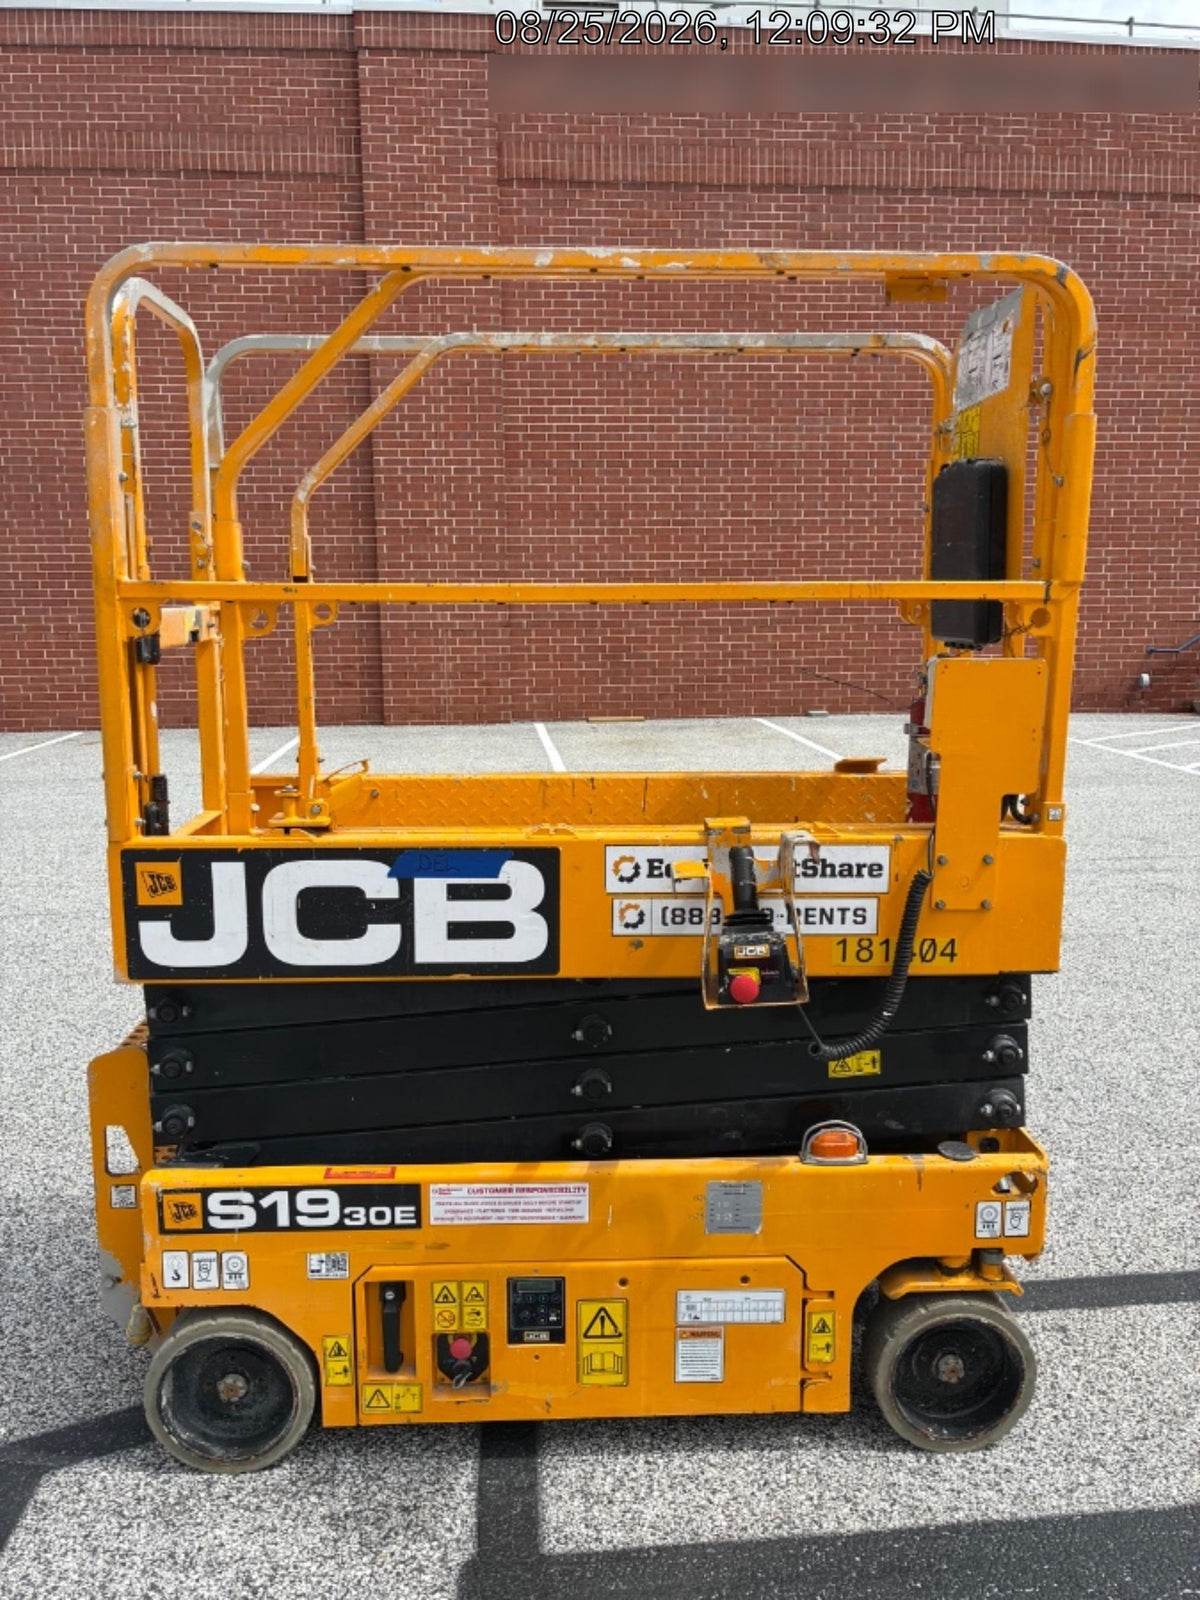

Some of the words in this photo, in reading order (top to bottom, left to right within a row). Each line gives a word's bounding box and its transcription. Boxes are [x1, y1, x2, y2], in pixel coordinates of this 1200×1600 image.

[147, 872, 178, 896] JCB
[138, 860, 549, 968] JCB
[836, 937, 958, 963] 18104
[172, 1202, 198, 1223] JCB
